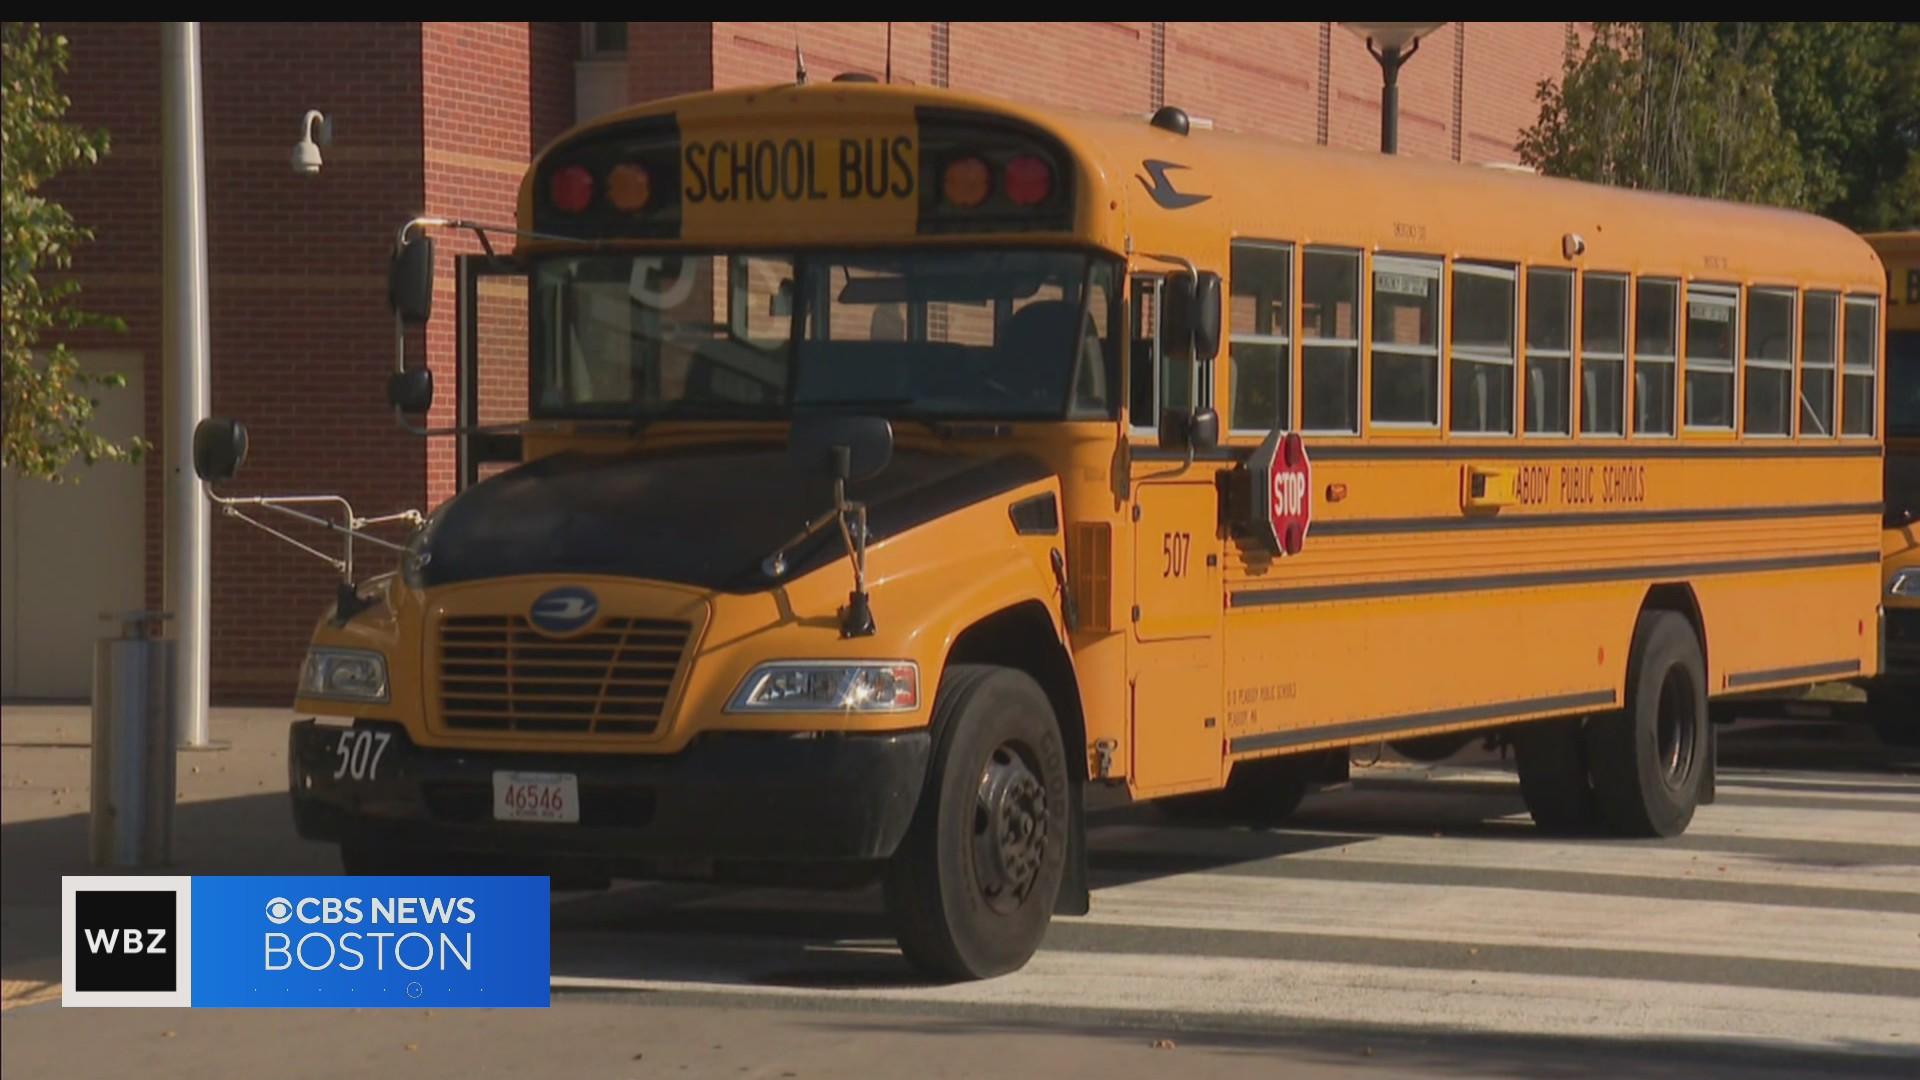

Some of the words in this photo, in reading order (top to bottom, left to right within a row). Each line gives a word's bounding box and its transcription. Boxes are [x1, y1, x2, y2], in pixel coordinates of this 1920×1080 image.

[685, 139, 827, 203] SCHOOL
[840, 136, 914, 199] BUS
[1274, 472, 1305, 516] STOP
[1512, 466, 1550, 504] ABODY
[1561, 466, 1594, 504] PUBLIC
[1603, 465, 1645, 503] SCHOOLS
[1163, 531, 1190, 578] 507
[334, 730, 391, 780] 507
[505, 784, 563, 811] 46546
